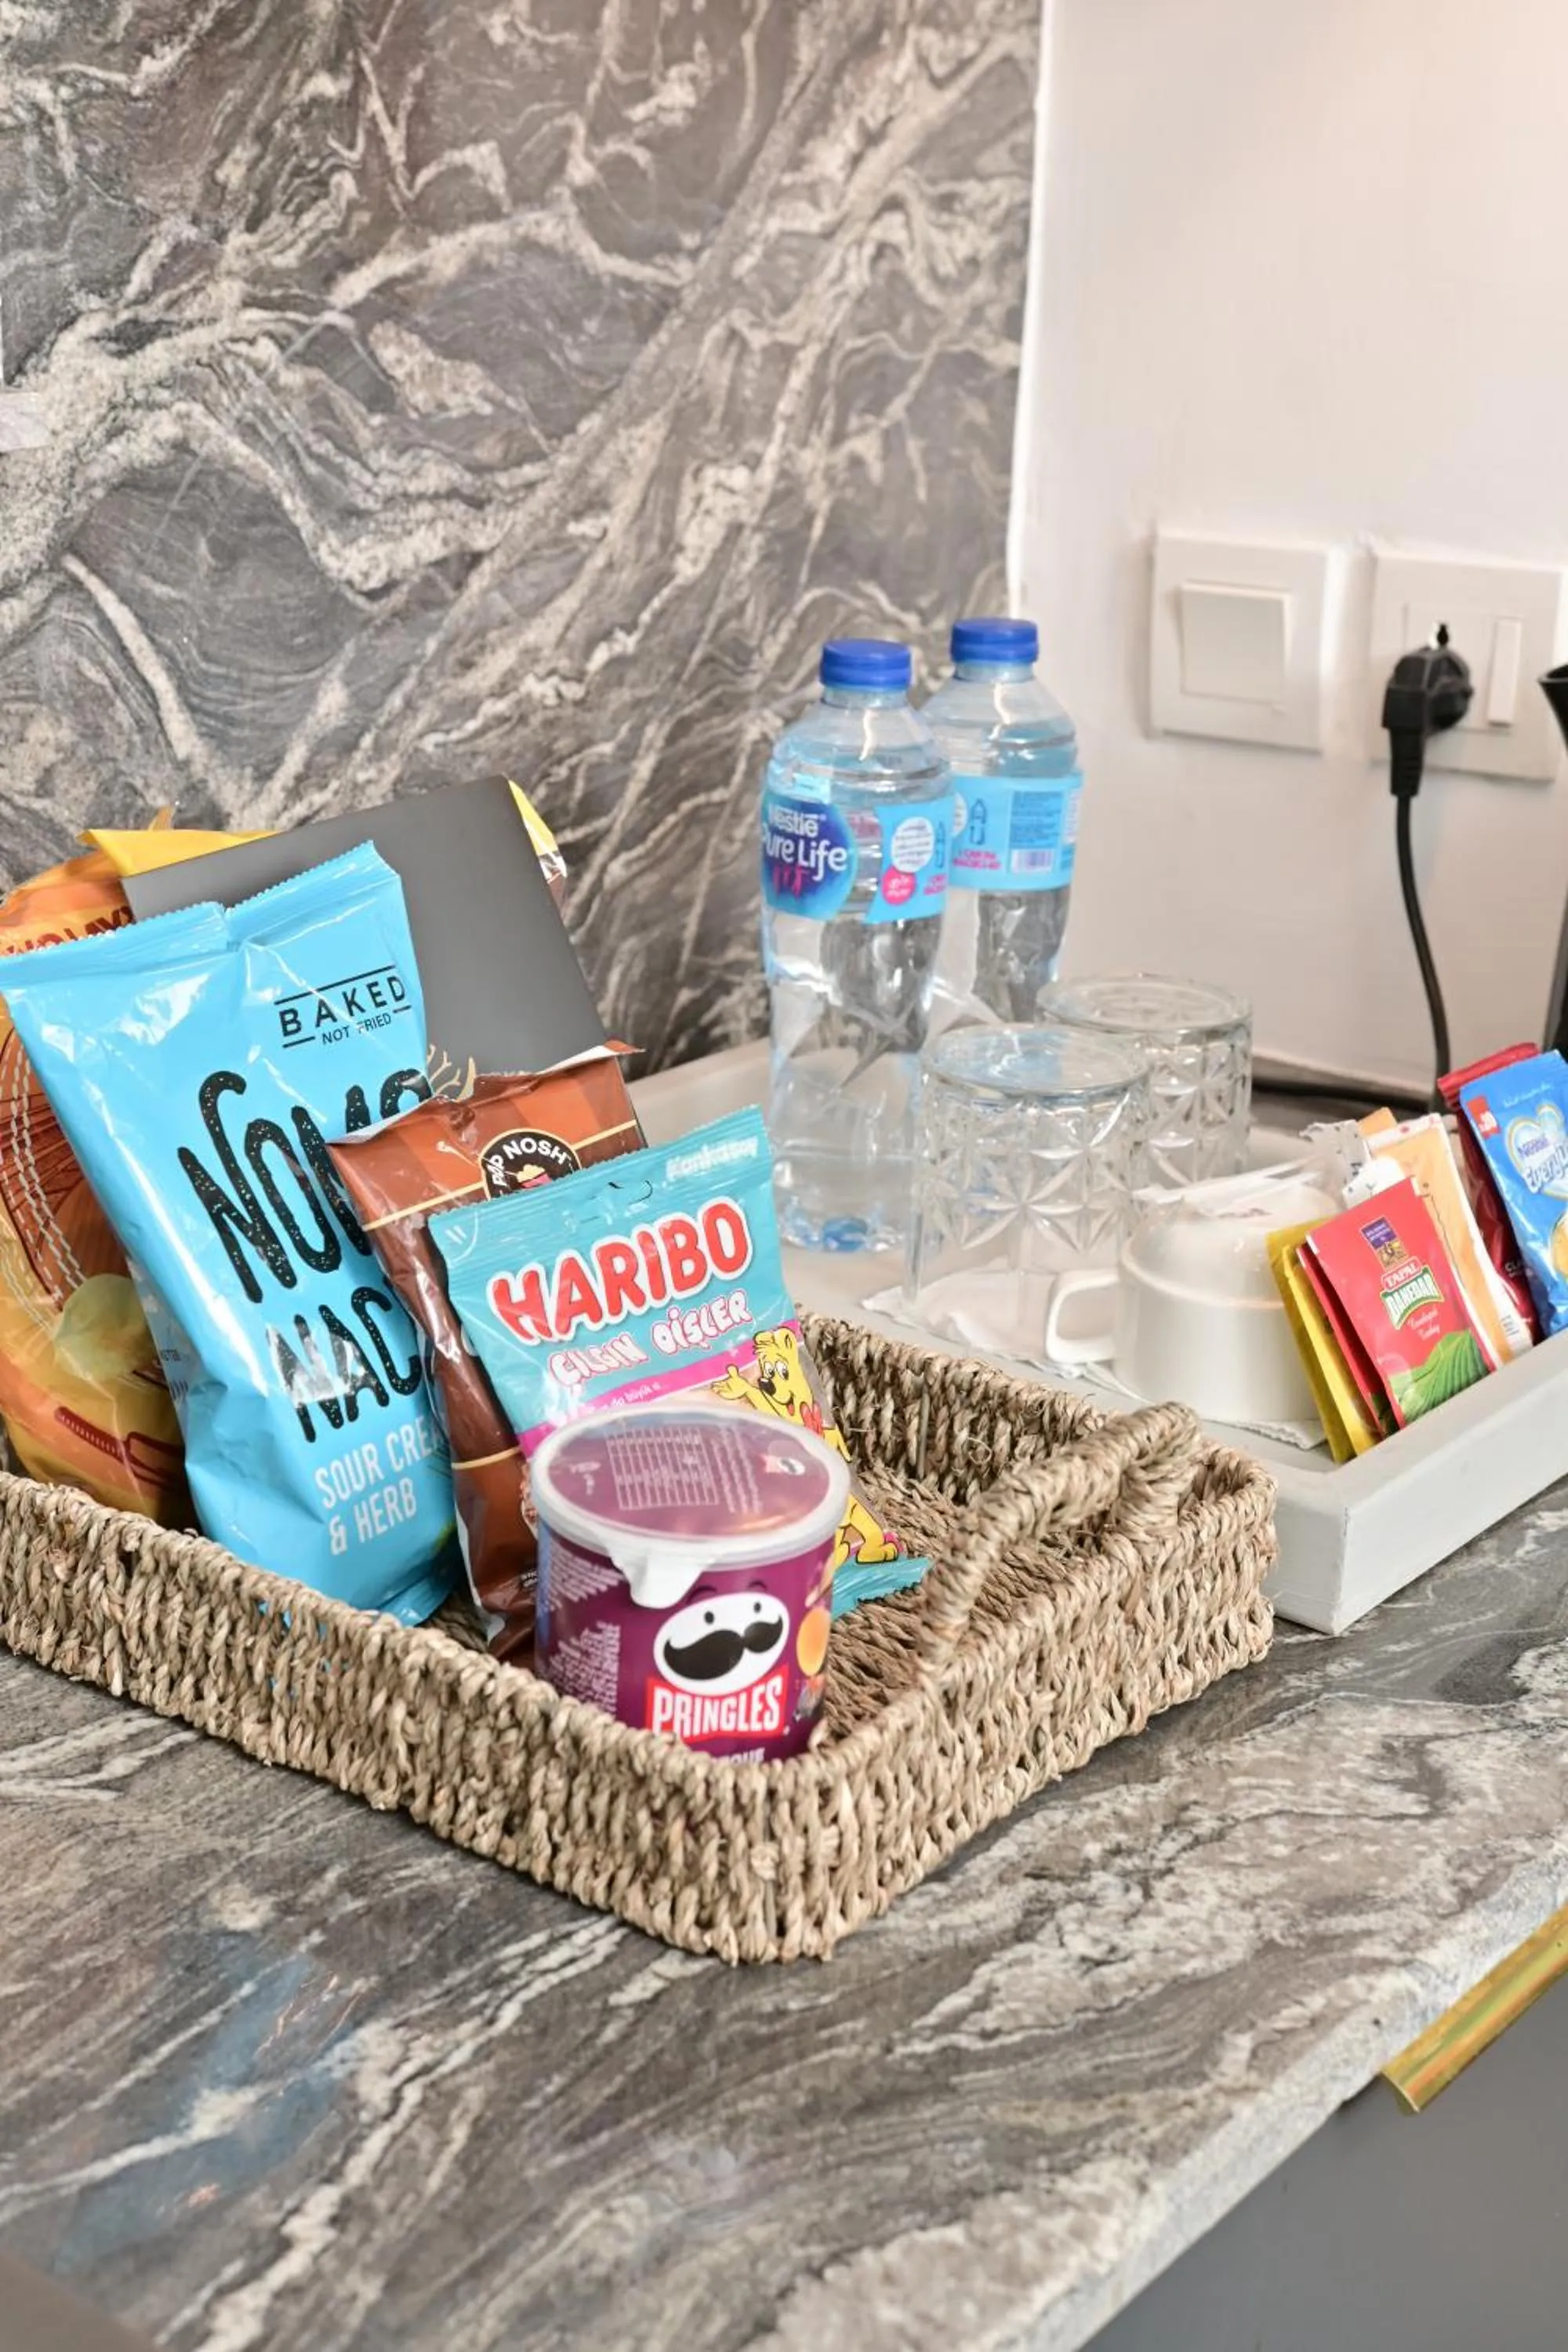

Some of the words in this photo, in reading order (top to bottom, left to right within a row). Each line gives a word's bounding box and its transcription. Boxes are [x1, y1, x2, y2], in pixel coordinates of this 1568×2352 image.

[798, 838, 848, 881] Life
[278, 976, 406, 1037] BAKED
[322, 1025, 350, 1045] NOT
[357, 1012, 392, 1035] FRIED
[503, 1137, 568, 1165] NOSH
[489, 1200, 750, 1344] HARIBO
[1385, 1262, 1419, 1287] TAPAL
[315, 1443, 385, 1509] SOUR
[329, 1515, 348, 1556] &
[354, 1478, 417, 1544] HERB
[652, 1675, 783, 1737] PRINGLES
